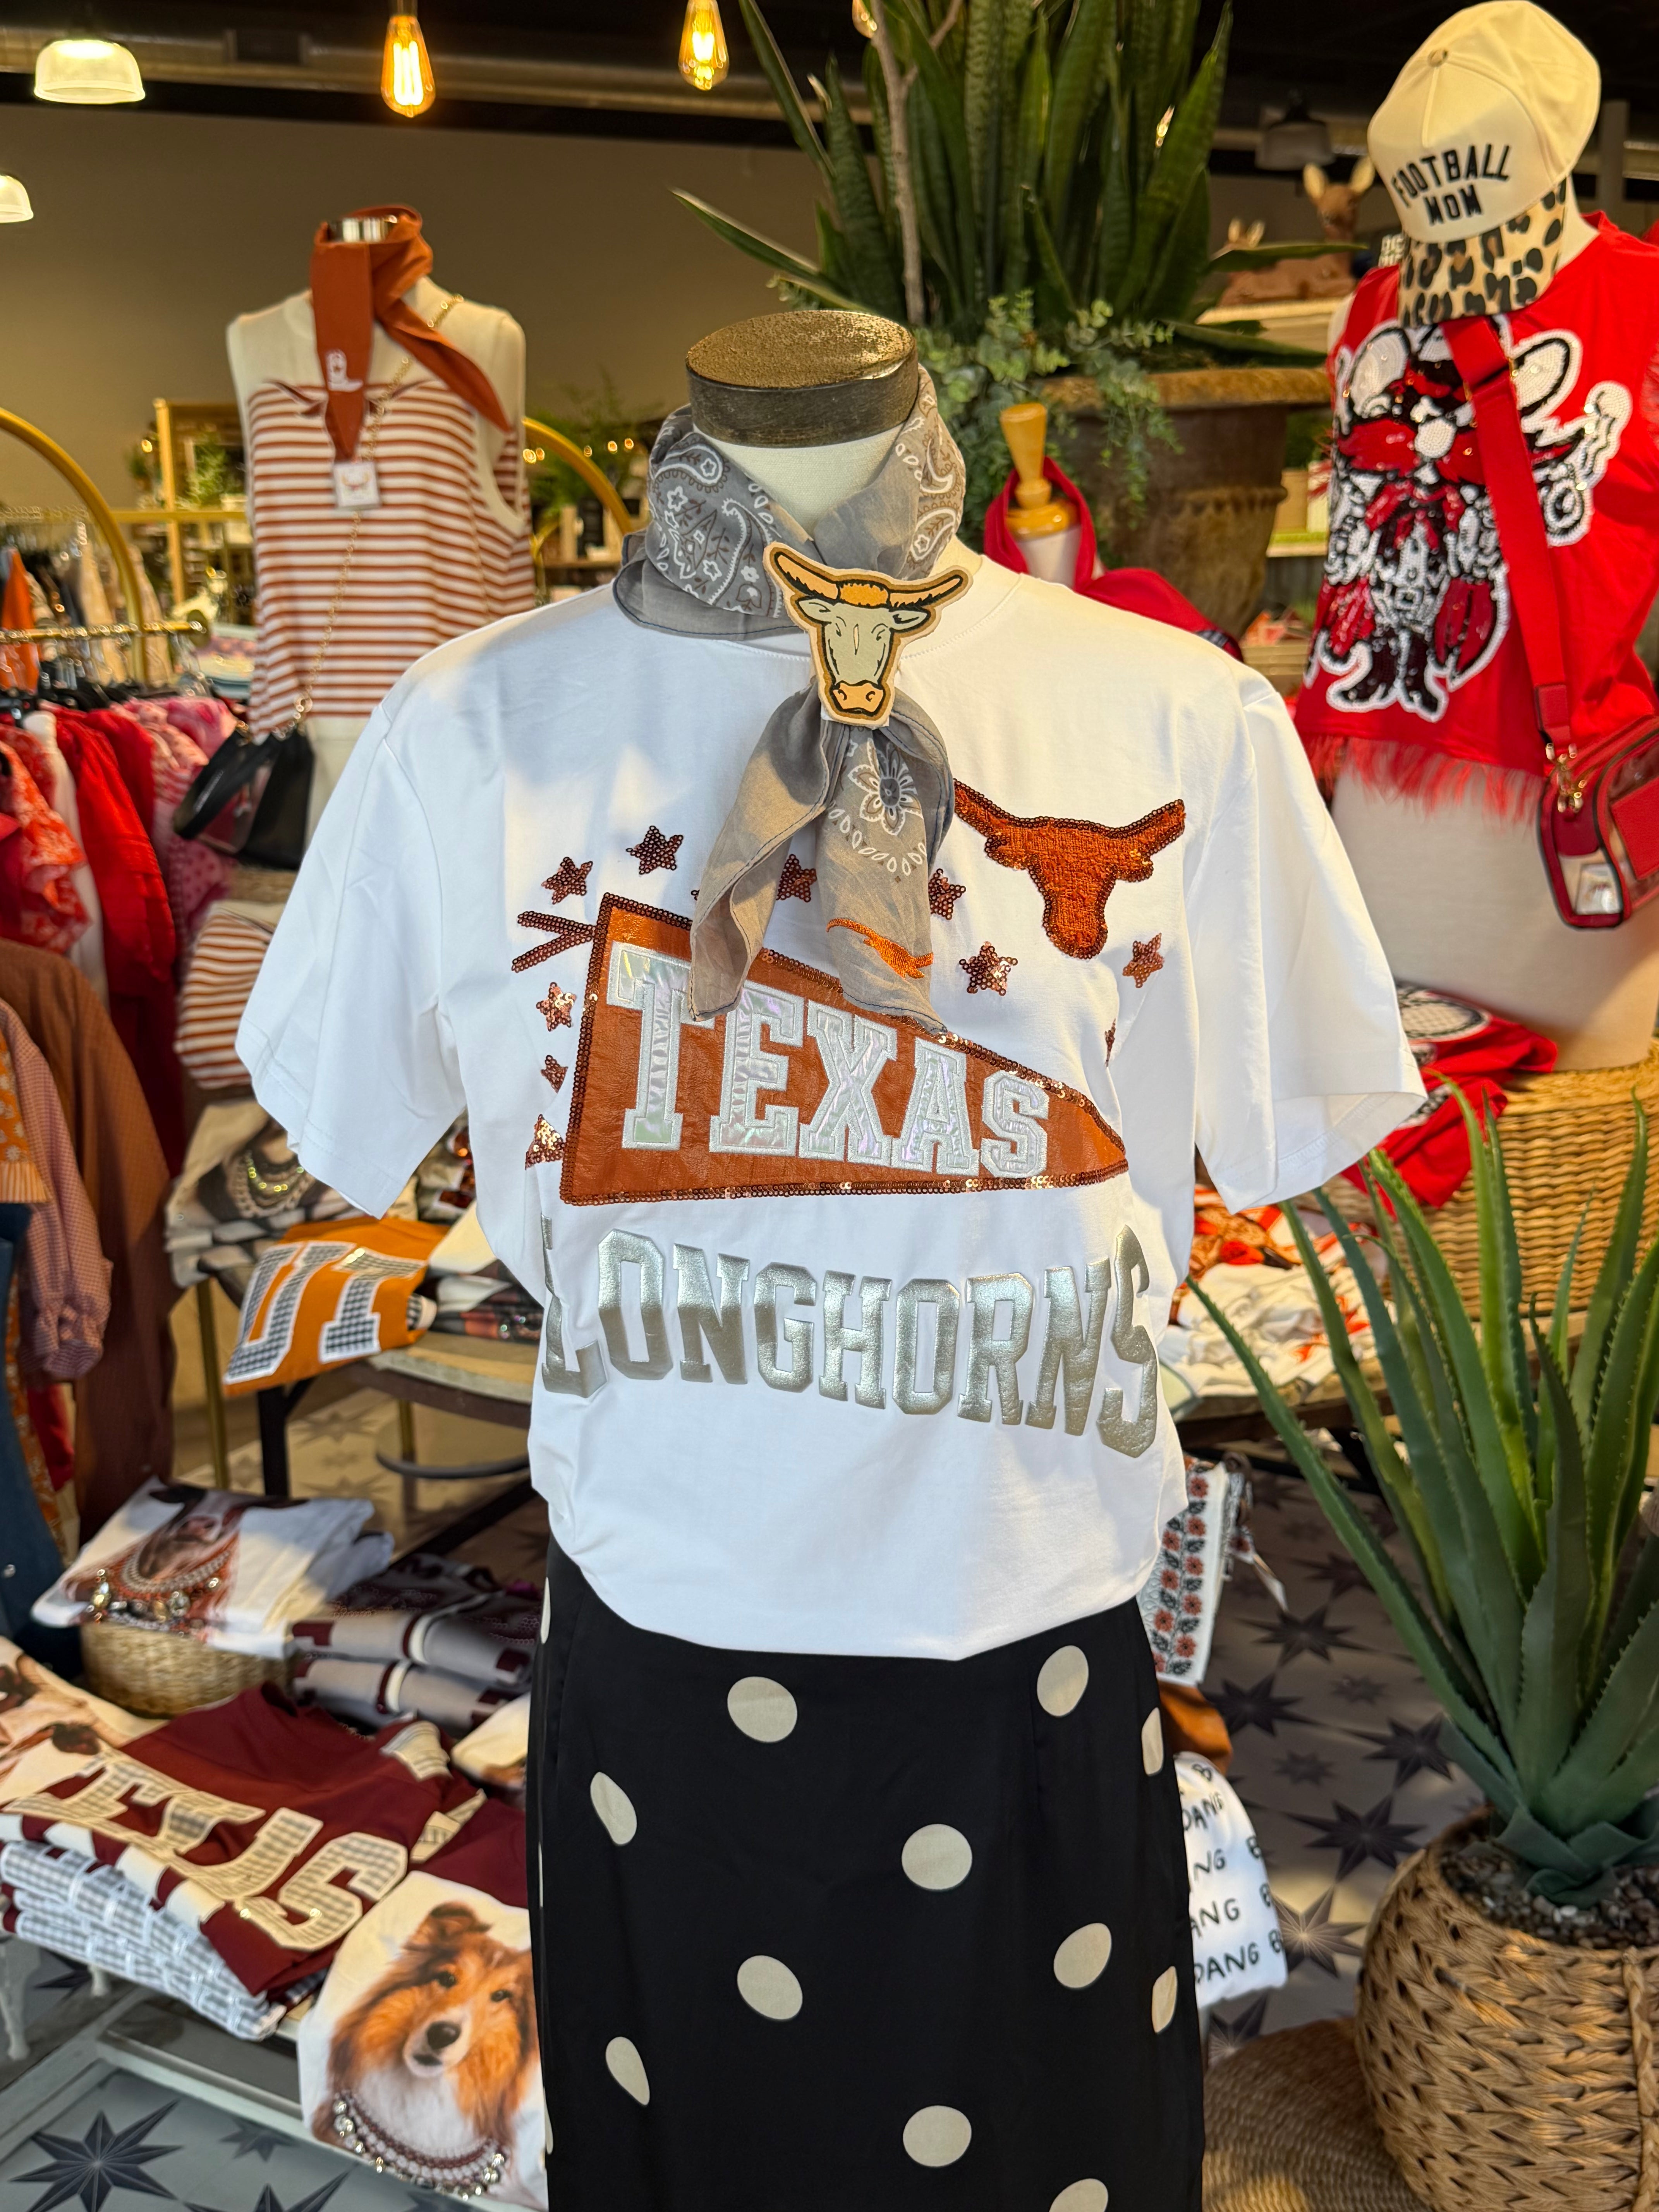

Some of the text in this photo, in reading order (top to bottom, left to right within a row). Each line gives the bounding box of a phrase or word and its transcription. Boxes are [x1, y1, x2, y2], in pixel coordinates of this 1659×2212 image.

[1391, 143, 1510, 208] FOOTBALL
[1423, 184, 1482, 225] MOM
[607, 942, 1050, 1179] TEXAS
[541, 1213, 1158, 1458] LONGHORNS
